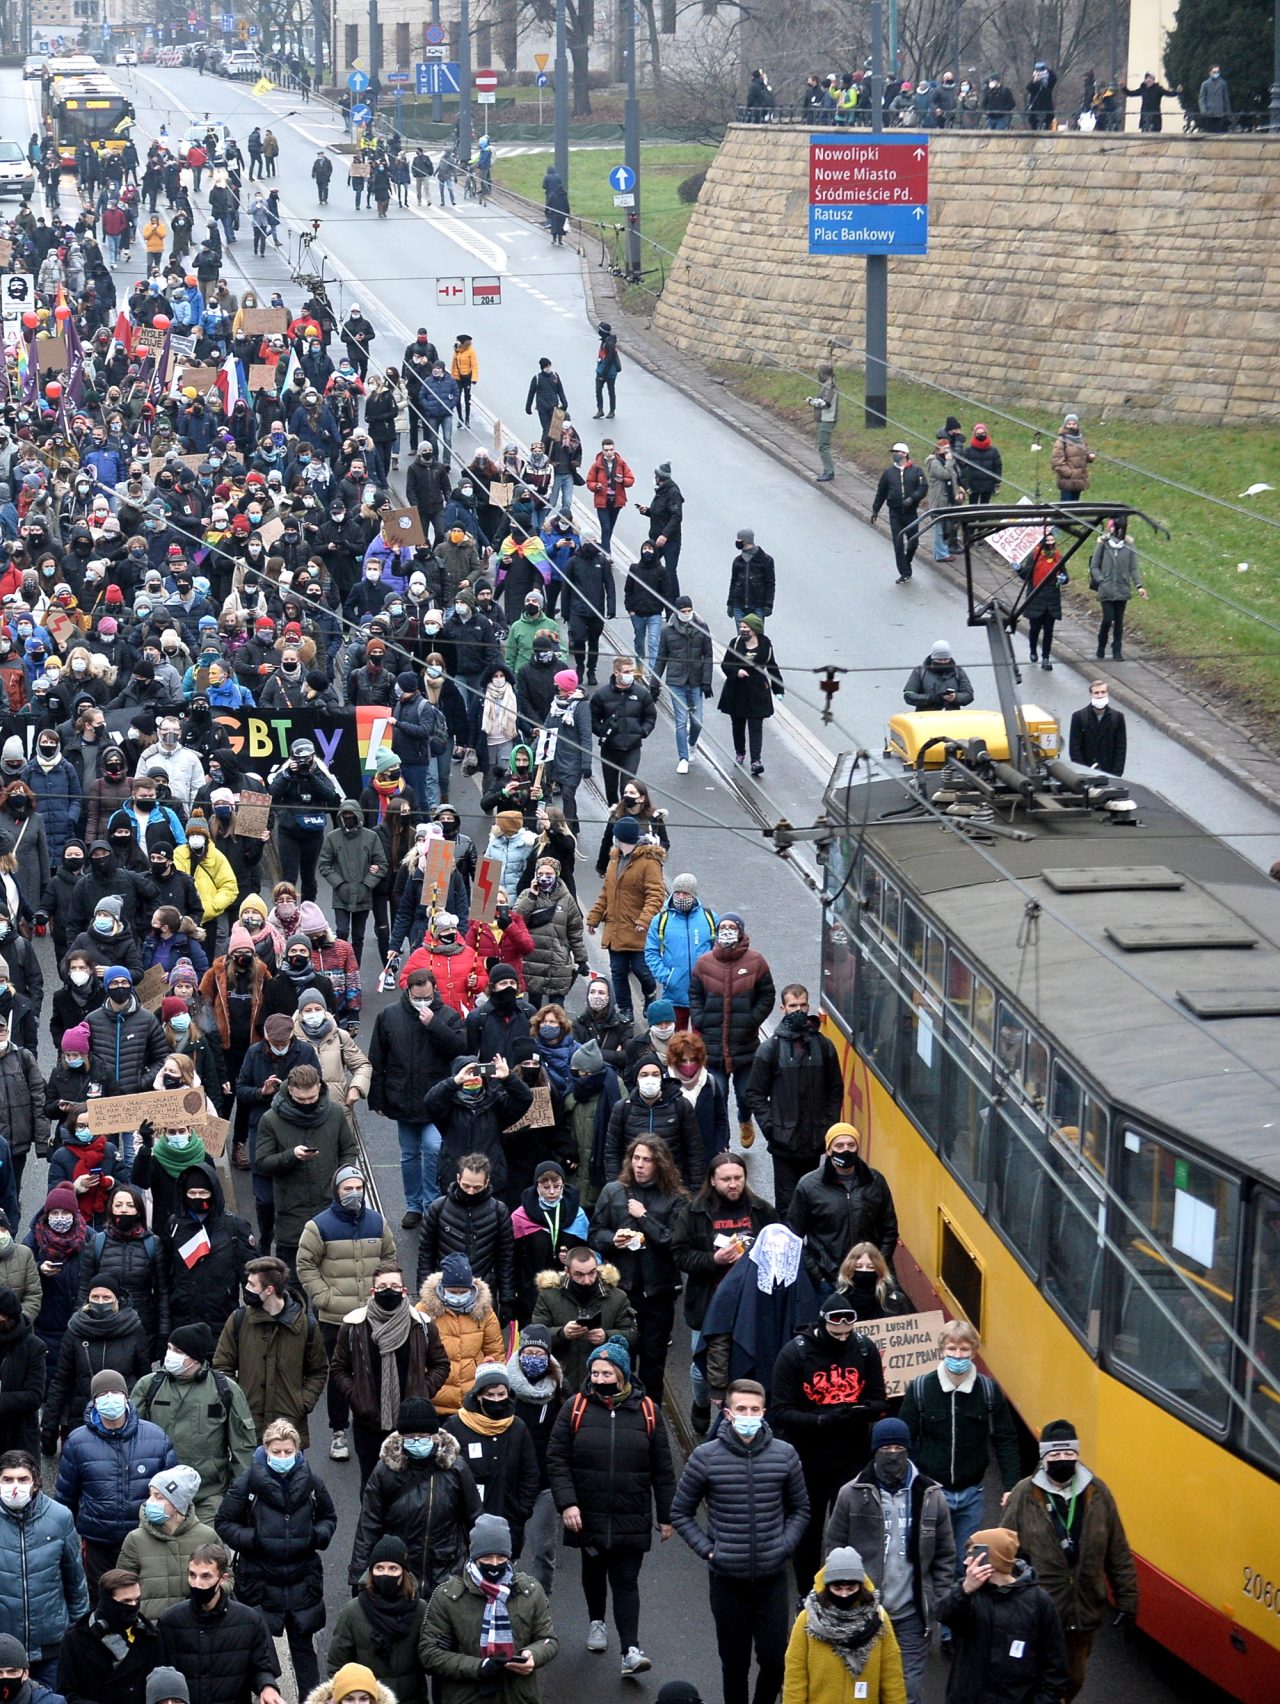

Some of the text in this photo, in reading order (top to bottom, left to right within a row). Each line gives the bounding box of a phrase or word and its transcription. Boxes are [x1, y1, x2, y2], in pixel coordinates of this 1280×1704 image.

[815, 147, 879, 163] Nowolipki
[815, 168, 897, 181] Nowe Miasto
[815, 185, 913, 201] Śródmieście Pd.
[814, 208, 854, 221] Ratusz
[814, 227, 895, 244] Plac Bankowy
[481, 296, 494, 305] 204
